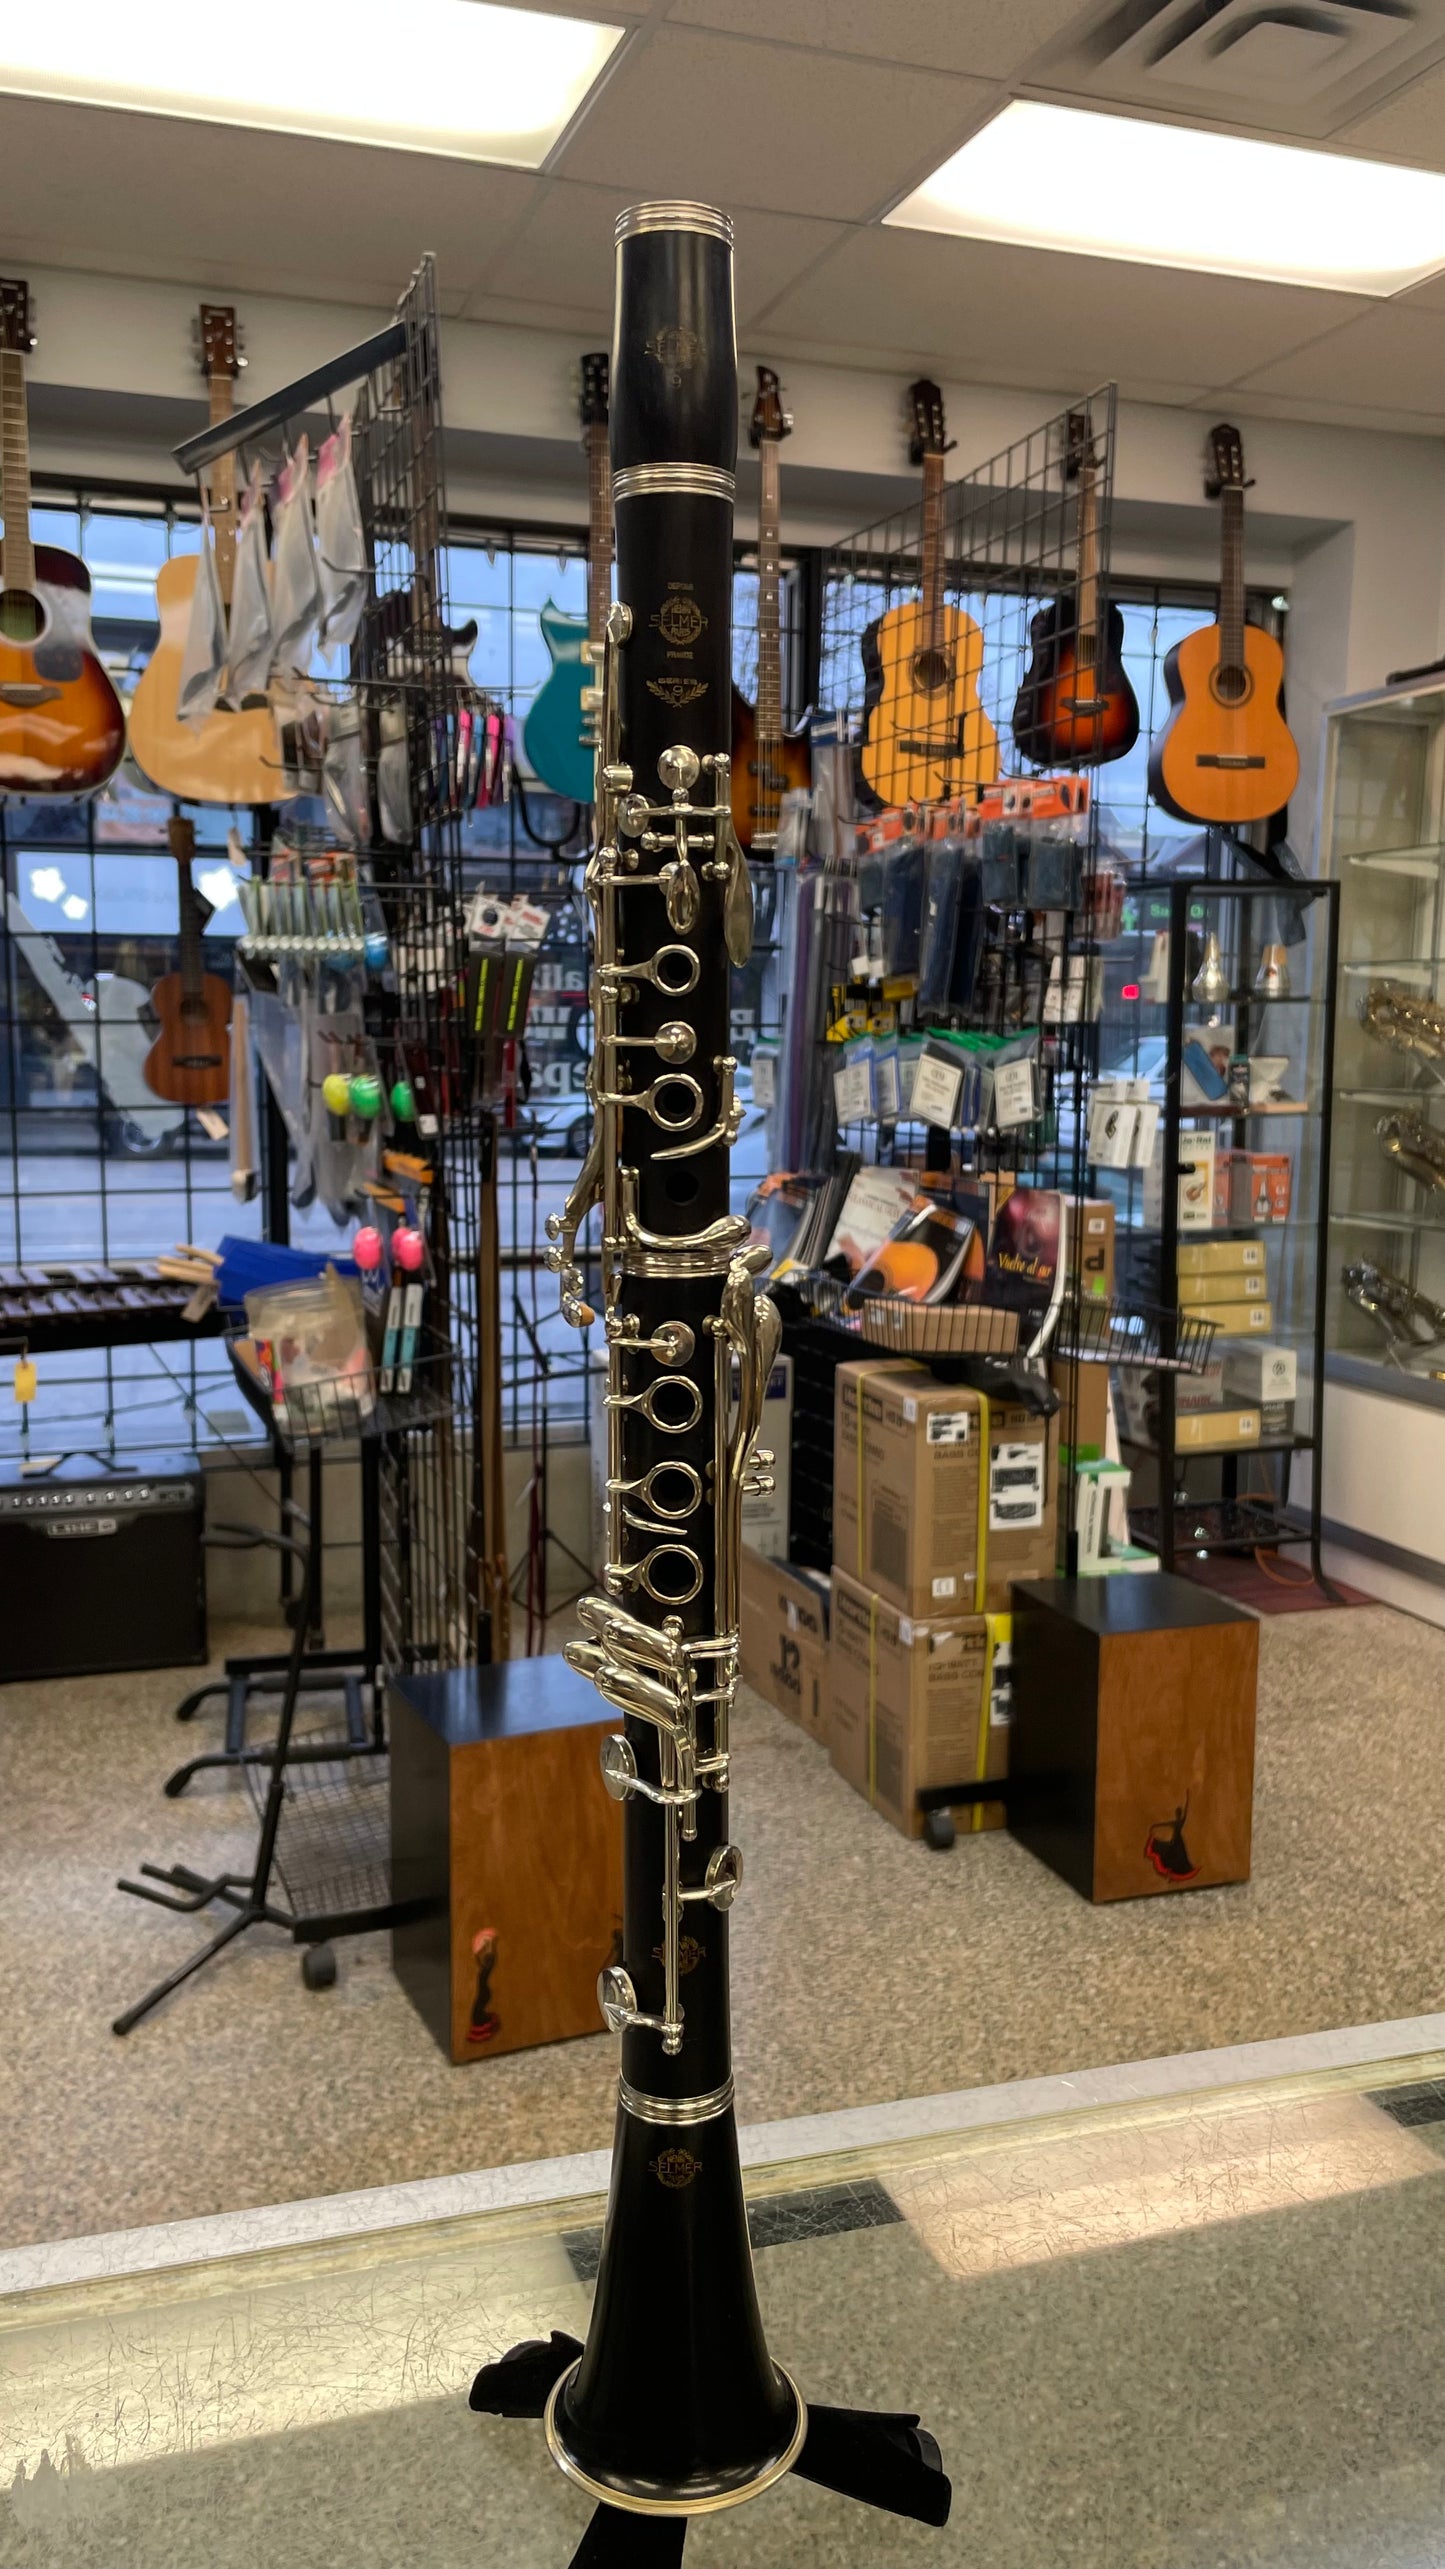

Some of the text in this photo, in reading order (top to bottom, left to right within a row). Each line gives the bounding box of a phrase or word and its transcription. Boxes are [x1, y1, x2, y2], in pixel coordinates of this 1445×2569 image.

[648, 613, 709, 629] SELMER
[658, 677, 698, 685] SERIES
[672, 685, 684, 697] 9
[647, 2160, 704, 2174] SELMER
